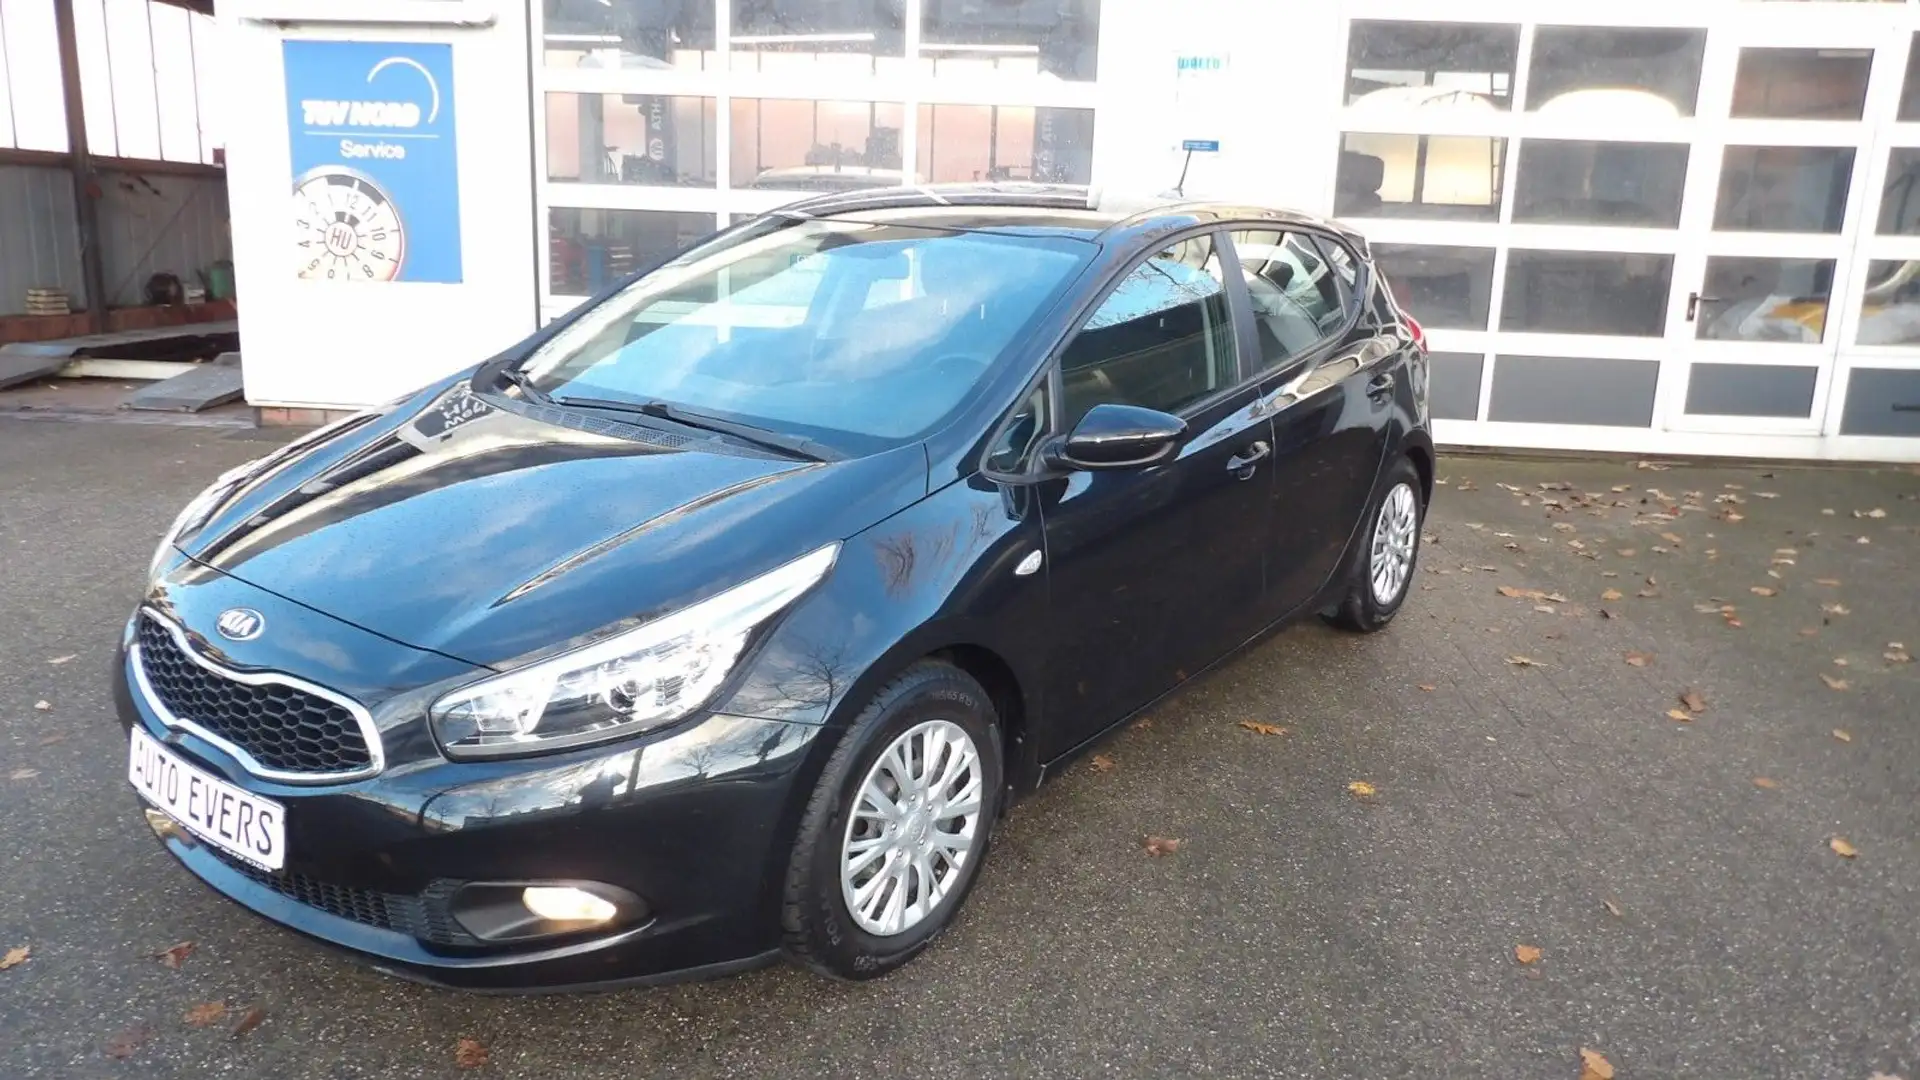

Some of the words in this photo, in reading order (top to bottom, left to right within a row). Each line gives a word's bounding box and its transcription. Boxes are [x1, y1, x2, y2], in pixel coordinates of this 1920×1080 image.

[349, 101, 420, 127] NORD
[340, 139, 405, 159] Service
[330, 227, 352, 250] HU
[370, 227, 387, 242] 10
[362, 264, 375, 279] 8
[218, 609, 259, 637] KIA
[135, 740, 178, 805] AUTO
[187, 776, 274, 856] EVERS
